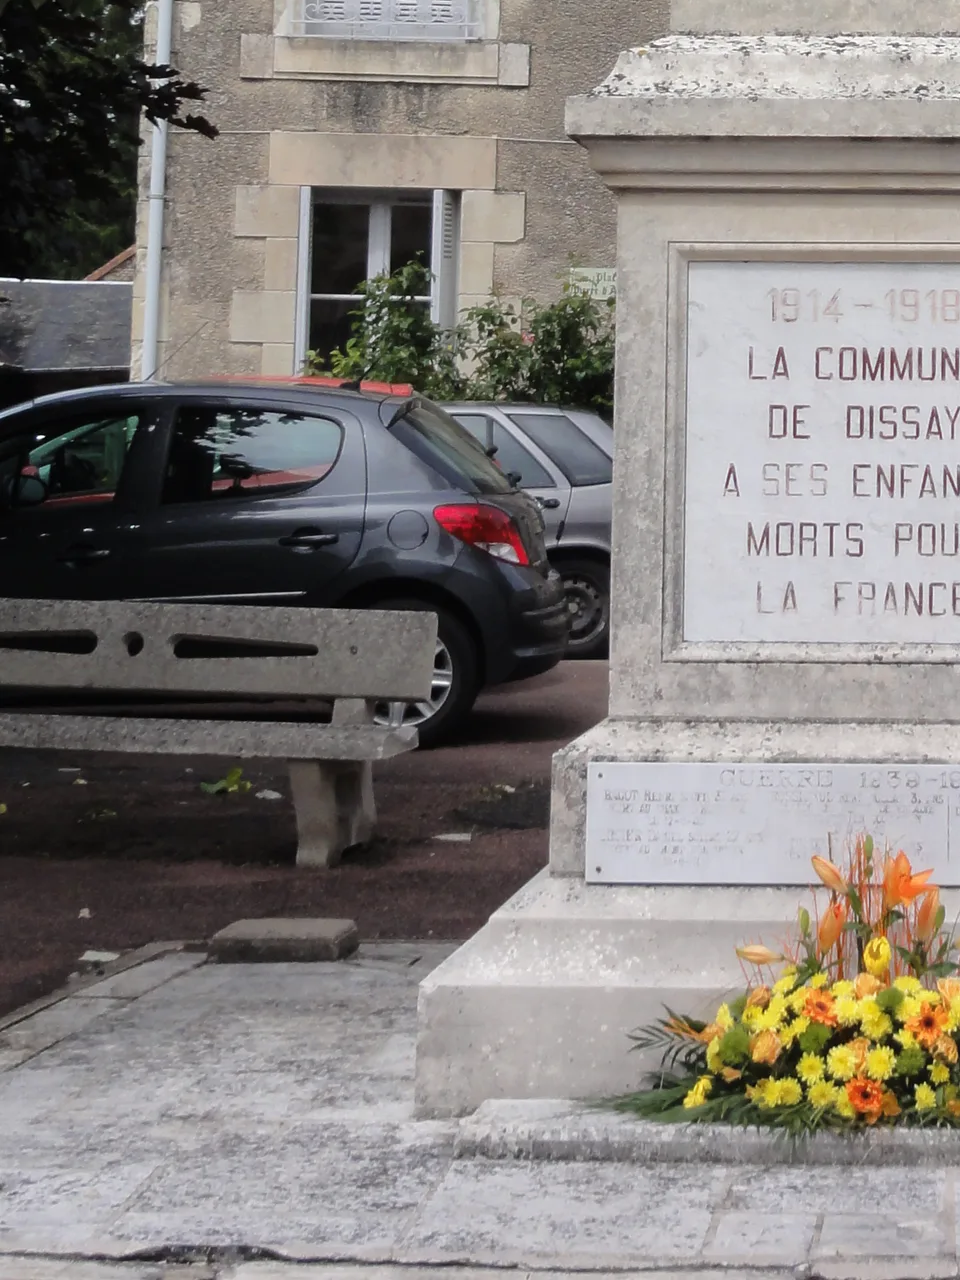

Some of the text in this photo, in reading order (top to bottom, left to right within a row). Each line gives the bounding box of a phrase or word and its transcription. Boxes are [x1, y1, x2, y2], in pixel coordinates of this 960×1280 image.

[748, 346, 790, 381] LA
[768, 404, 960, 440] DE DISSAY
[723, 463, 740, 497] A
[762, 463, 829, 497] SES
[747, 522, 864, 557] MORTS
[756, 580, 798, 614] LA
[719, 769, 833, 788] GUERRE
